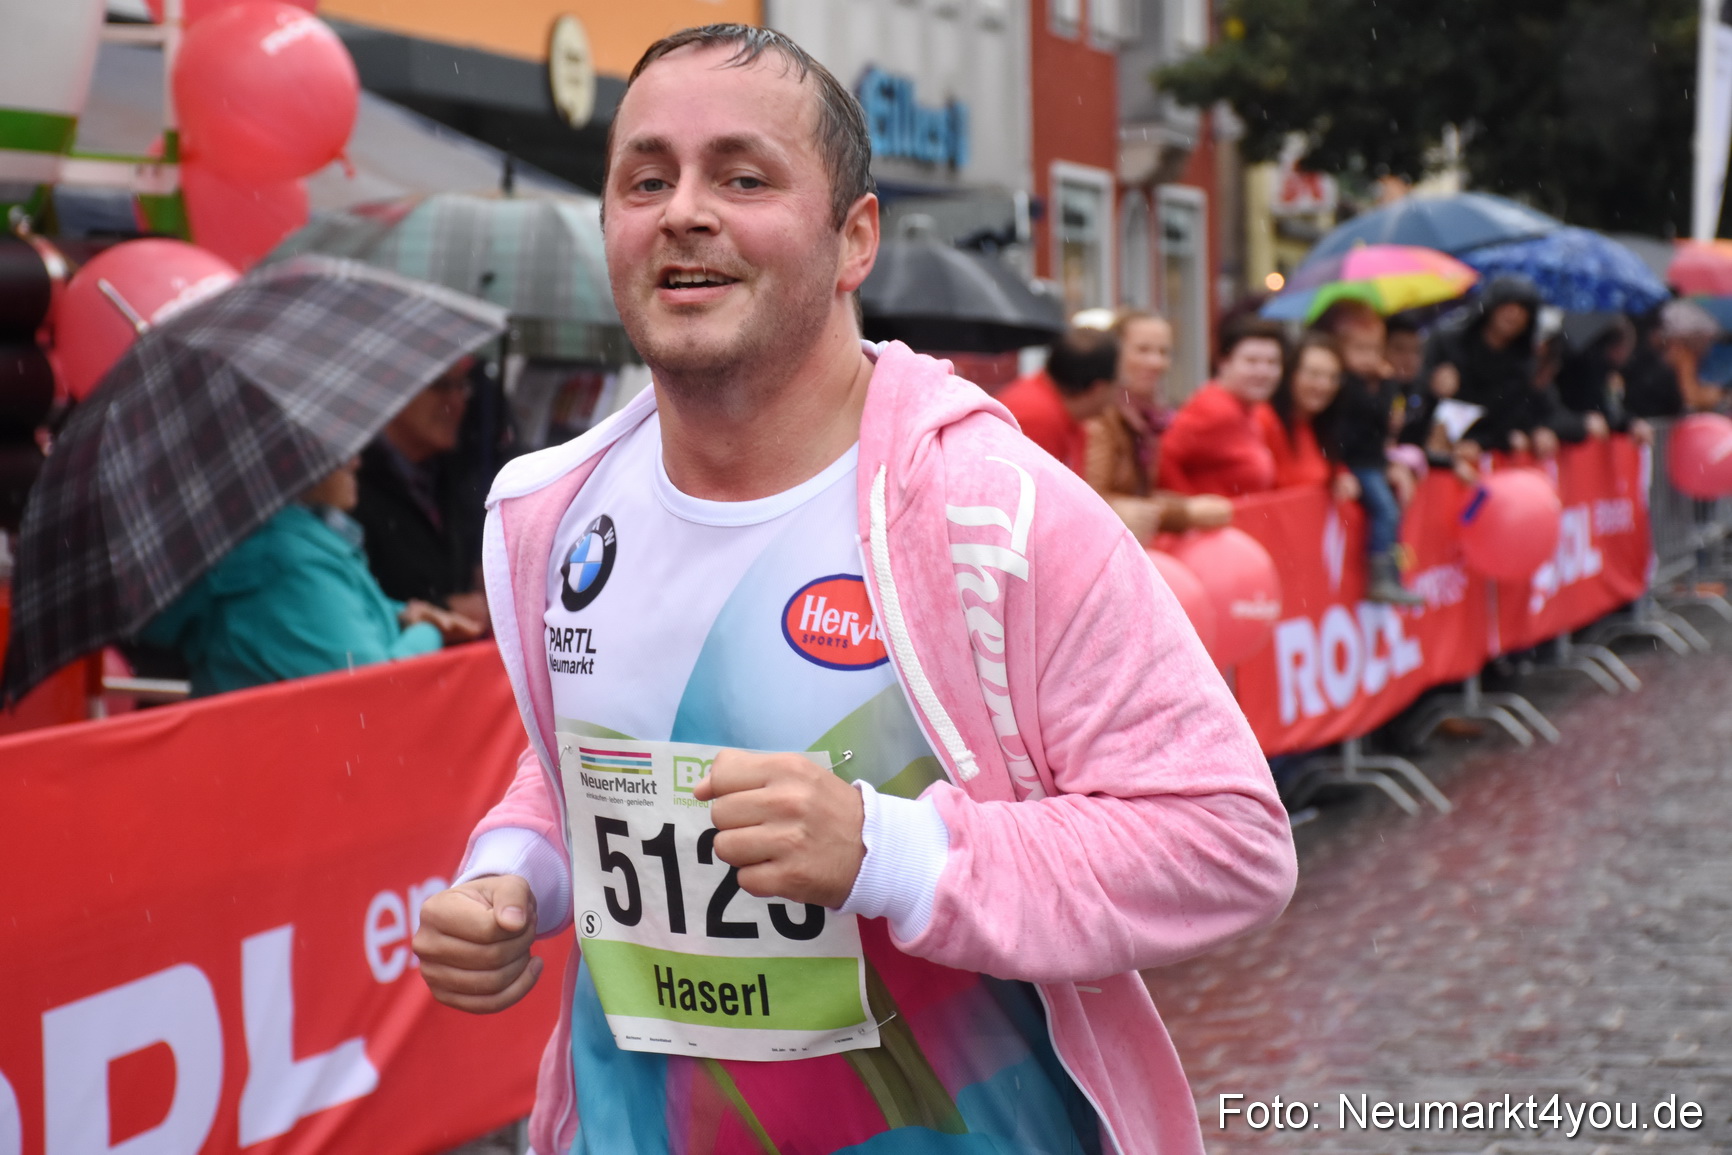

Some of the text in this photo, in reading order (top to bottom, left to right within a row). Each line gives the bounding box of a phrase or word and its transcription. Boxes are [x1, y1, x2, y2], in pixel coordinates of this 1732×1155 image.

[549, 627, 597, 654] PARTL
[802, 634, 848, 648] SPORTS
[549, 653, 594, 675] Neumarkt
[580, 772, 657, 795] NeuerMarkt
[654, 964, 770, 1016] Haserl
[0, 922, 380, 1155] DL
